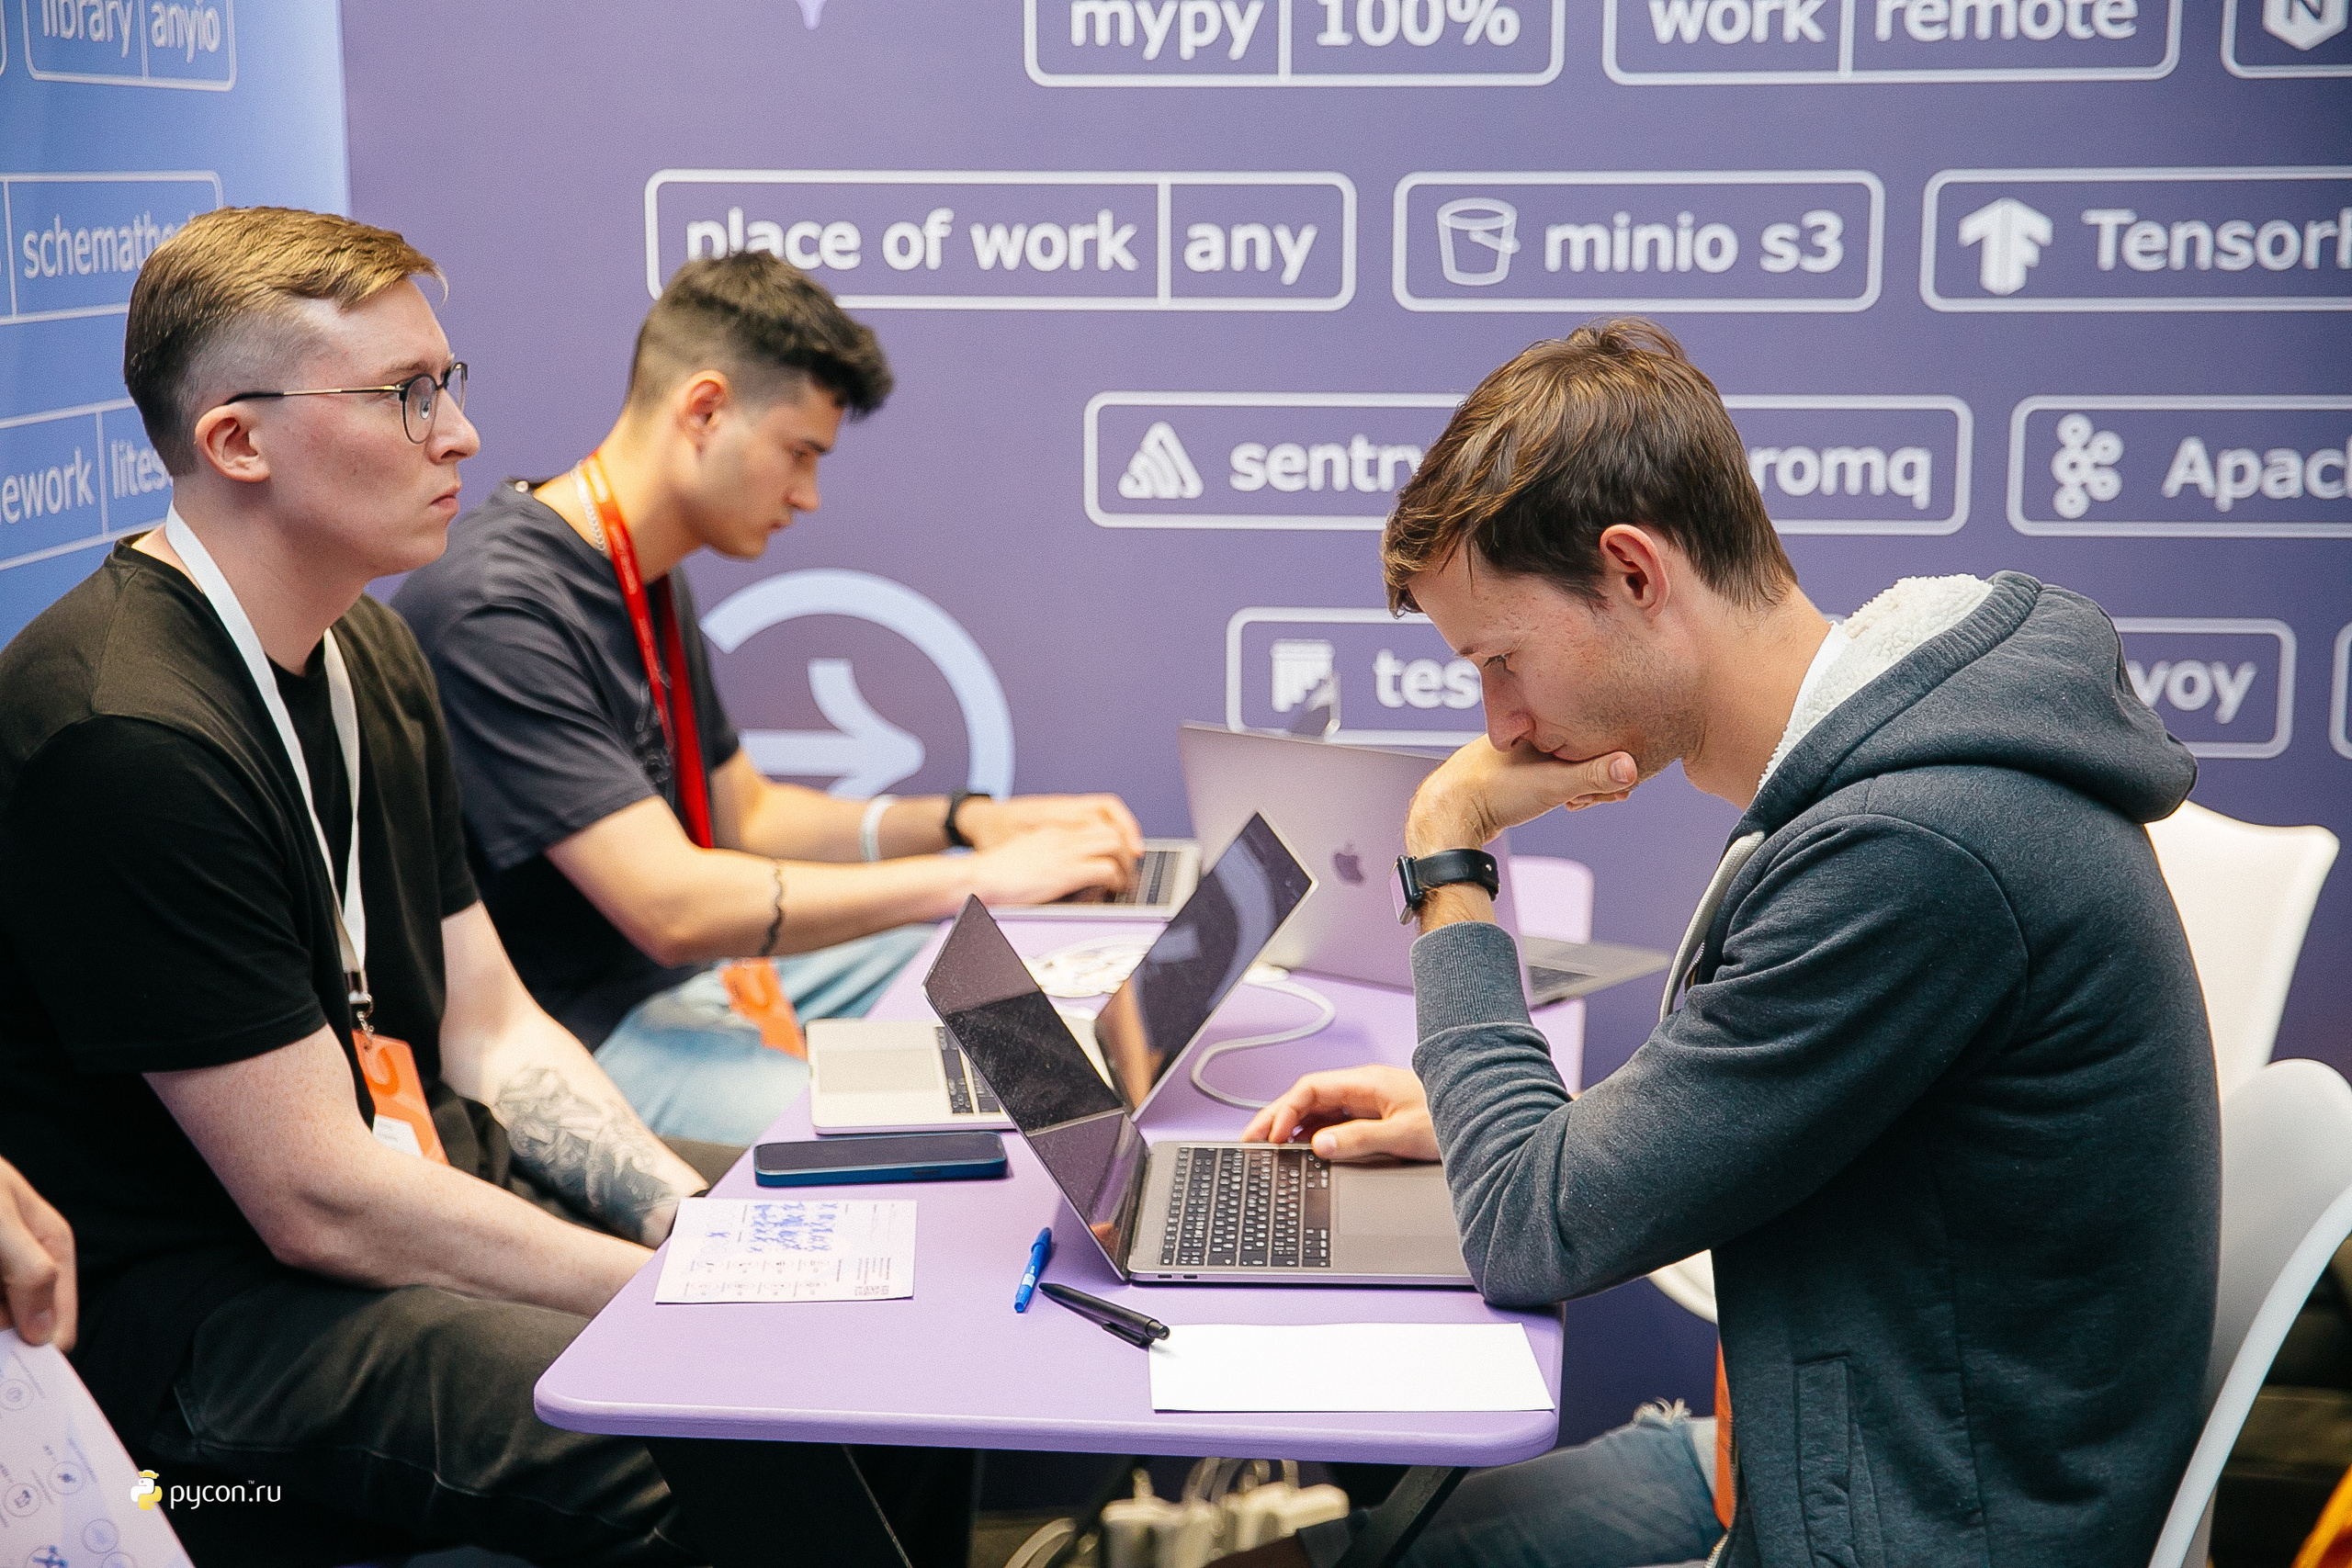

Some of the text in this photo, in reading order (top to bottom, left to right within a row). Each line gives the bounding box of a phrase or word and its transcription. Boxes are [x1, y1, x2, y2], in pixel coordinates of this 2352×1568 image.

[40, 0, 221, 63] library anyio
[1070, 0, 1521, 61] mypy 100%
[1648, 0, 2138, 44] work remote
[882, 208, 955, 270] of
[970, 209, 1139, 271] work
[1183, 223, 1317, 285] any
[1544, 209, 1844, 273] minio s3
[0, 439, 173, 525] ework lites
[1747, 446, 1932, 511] romq
[2161, 435, 2352, 513] Apac
[1372, 649, 1481, 709] tes
[2127, 659, 2258, 725] voy
